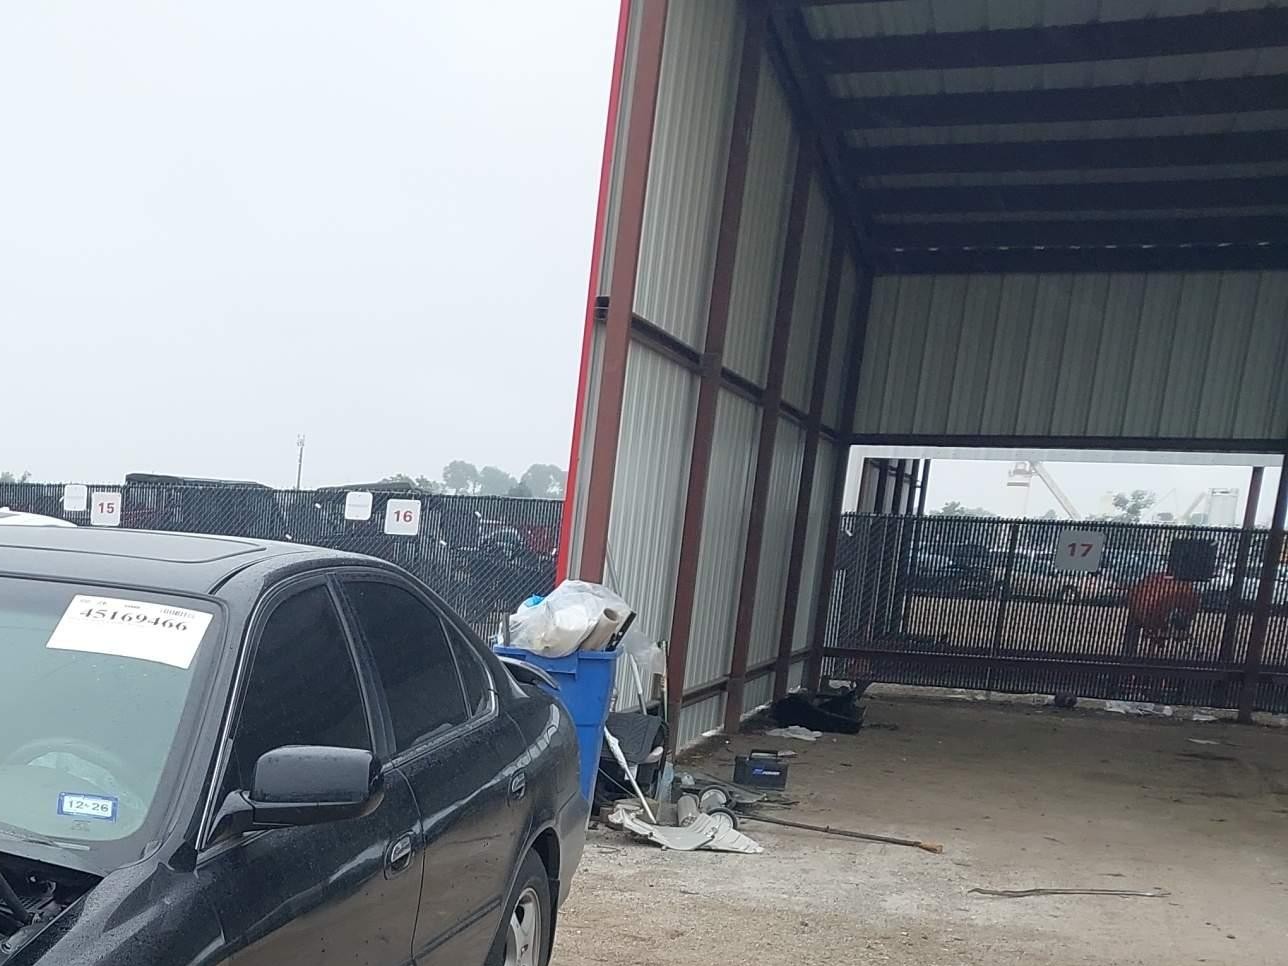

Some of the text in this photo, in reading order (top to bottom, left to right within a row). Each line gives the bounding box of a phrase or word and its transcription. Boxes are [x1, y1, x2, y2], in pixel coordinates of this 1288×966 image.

[98, 502, 115, 514] 15
[393, 510, 413, 523] 16
[1067, 543, 1094, 558] 17
[79, 607, 188, 632] 45169466
